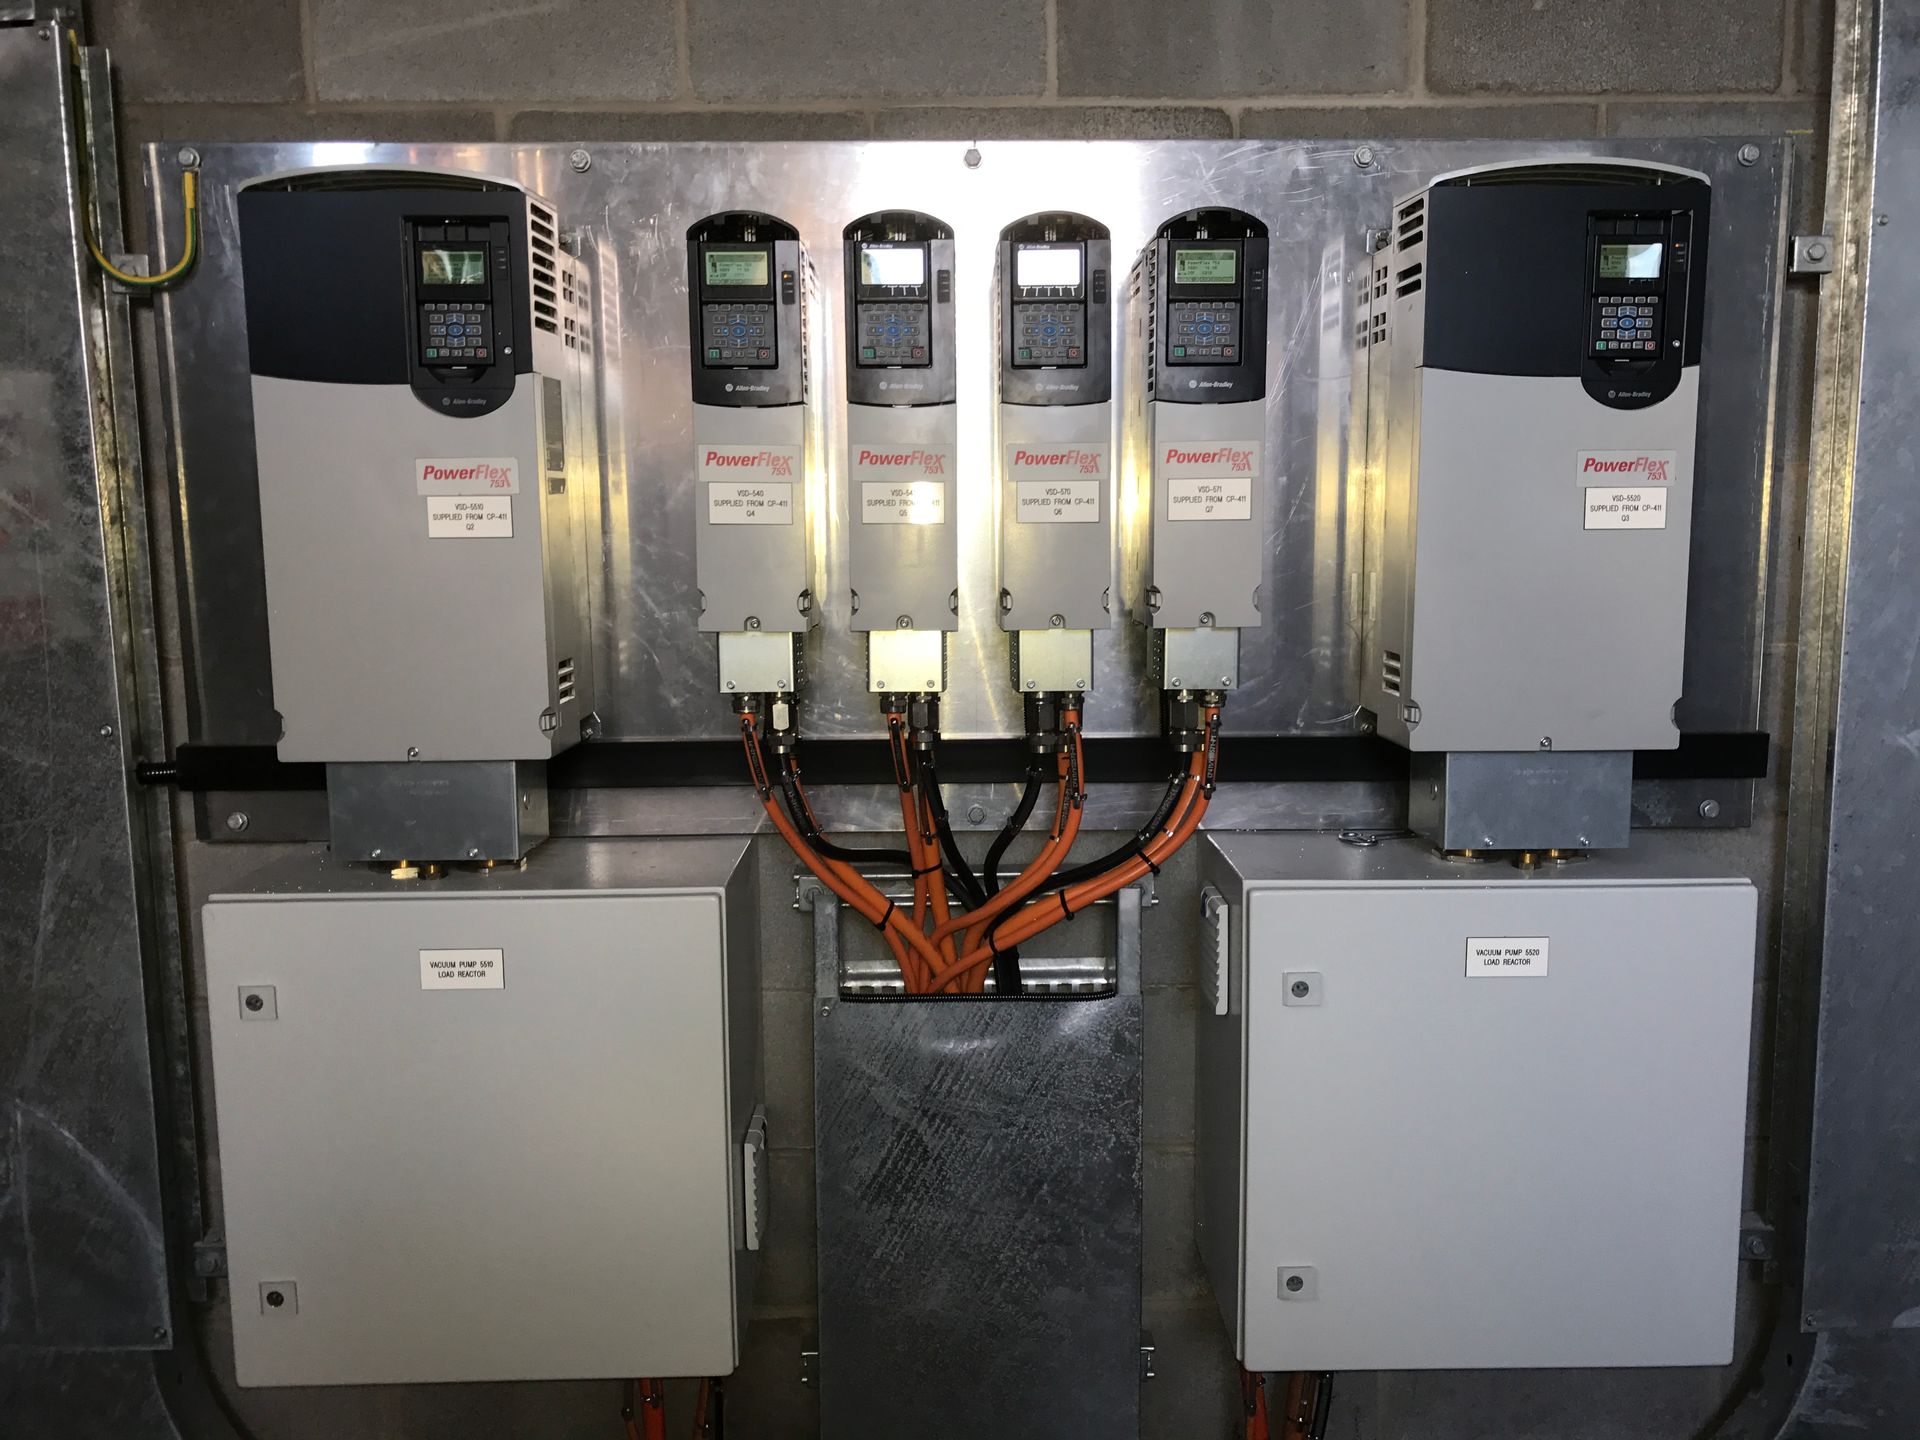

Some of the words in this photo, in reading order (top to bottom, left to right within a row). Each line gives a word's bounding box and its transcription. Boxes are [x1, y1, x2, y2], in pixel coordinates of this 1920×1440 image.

[1198, 381, 1233, 389] Allen-Bradley
[705, 451, 793, 476] PowerFlex
[858, 450, 946, 474] PowerFlex
[1014, 449, 1102, 473] PowerFlex
[1165, 448, 1253, 471] PowerFlex
[924, 465, 939, 474] 753
[1079, 465, 1094, 473] 753
[1231, 463, 1246, 471] 753
[1583, 457, 1669, 480] PowerFlex
[423, 464, 512, 487] PowerFlex
[771, 467, 786, 476] 753
[1647, 472, 1662, 480] 753
[490, 479, 505, 488] 753
[1612, 494, 1641, 502] VSD-5520
[454, 503, 484, 511] VSD-5510
[713, 499, 743, 507] SUPPLIED
[866, 499, 896, 507] SUPPLIED
[1205, 505, 1214, 513] Q7
[432, 513, 462, 521] SUPPLIED
[1621, 514, 1630, 522] Q3
[1525, 948, 1540, 956] 5520
[429, 961, 456, 969] VACUUM
[480, 960, 494, 968] 5510
[1483, 958, 1500, 966] LOAD
[1502, 958, 1531, 966] REACTOR
[457, 970, 486, 978] REACTOR
